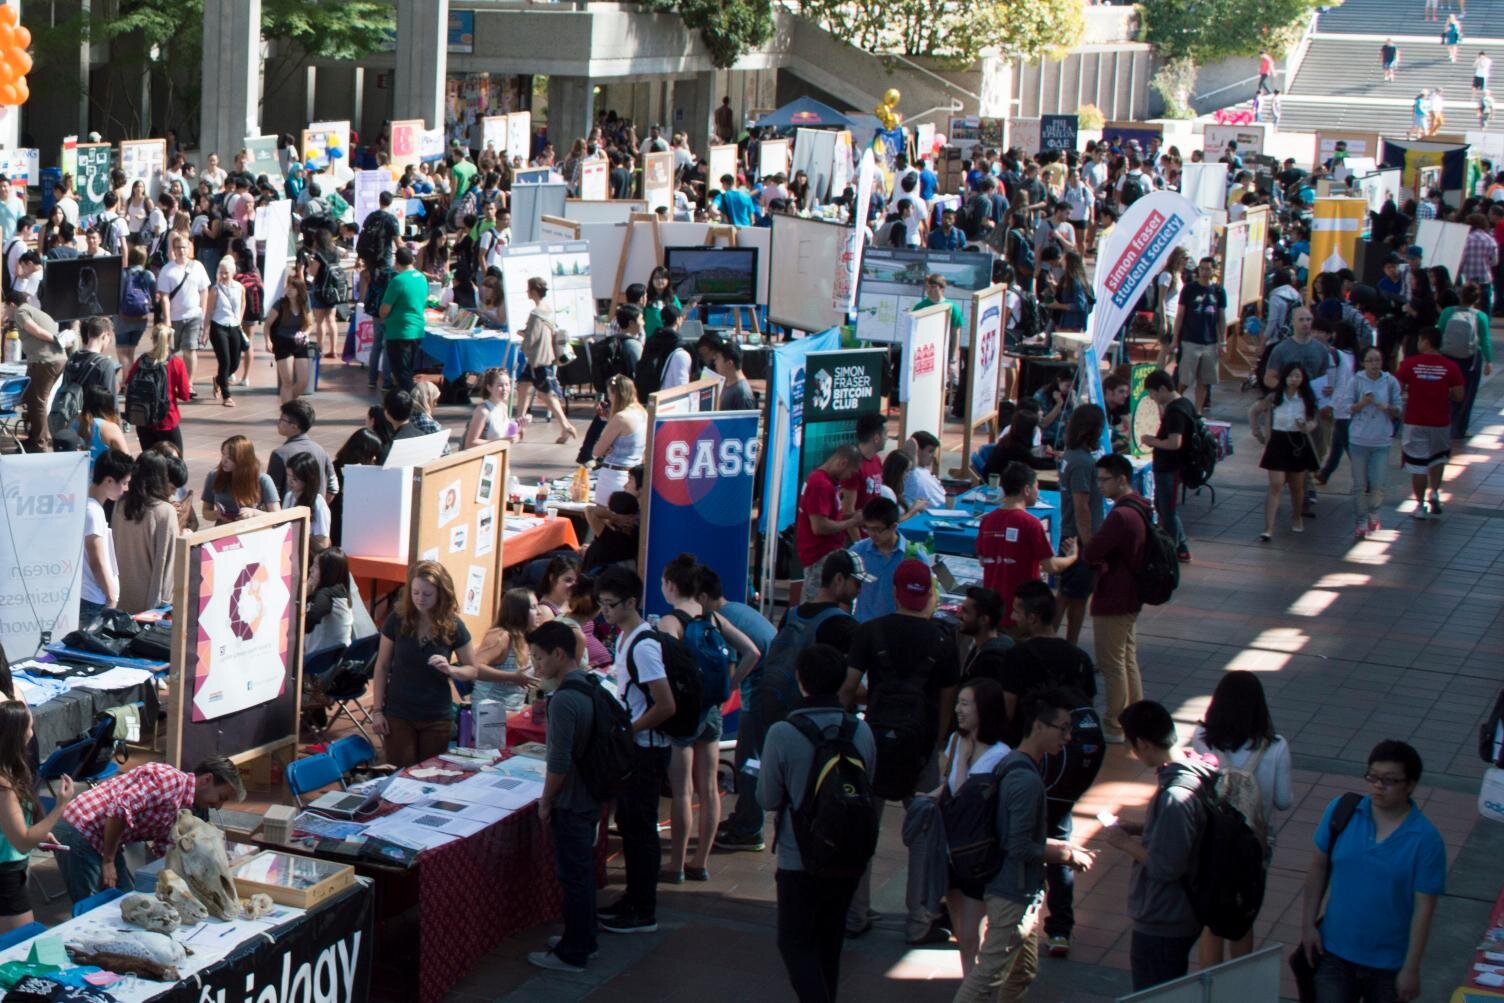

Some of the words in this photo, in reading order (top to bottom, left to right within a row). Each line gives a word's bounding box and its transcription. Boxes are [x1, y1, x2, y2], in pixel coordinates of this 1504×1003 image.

[1109, 250, 1137, 289] simon
[1132, 213, 1162, 251] fraser
[1116, 257, 1151, 304] student
[1147, 217, 1182, 259] society
[834, 366, 865, 378] SIMON
[834, 376, 871, 388] FRASER
[833, 387, 873, 399] BITCOIN
[832, 399, 859, 410] CLUB
